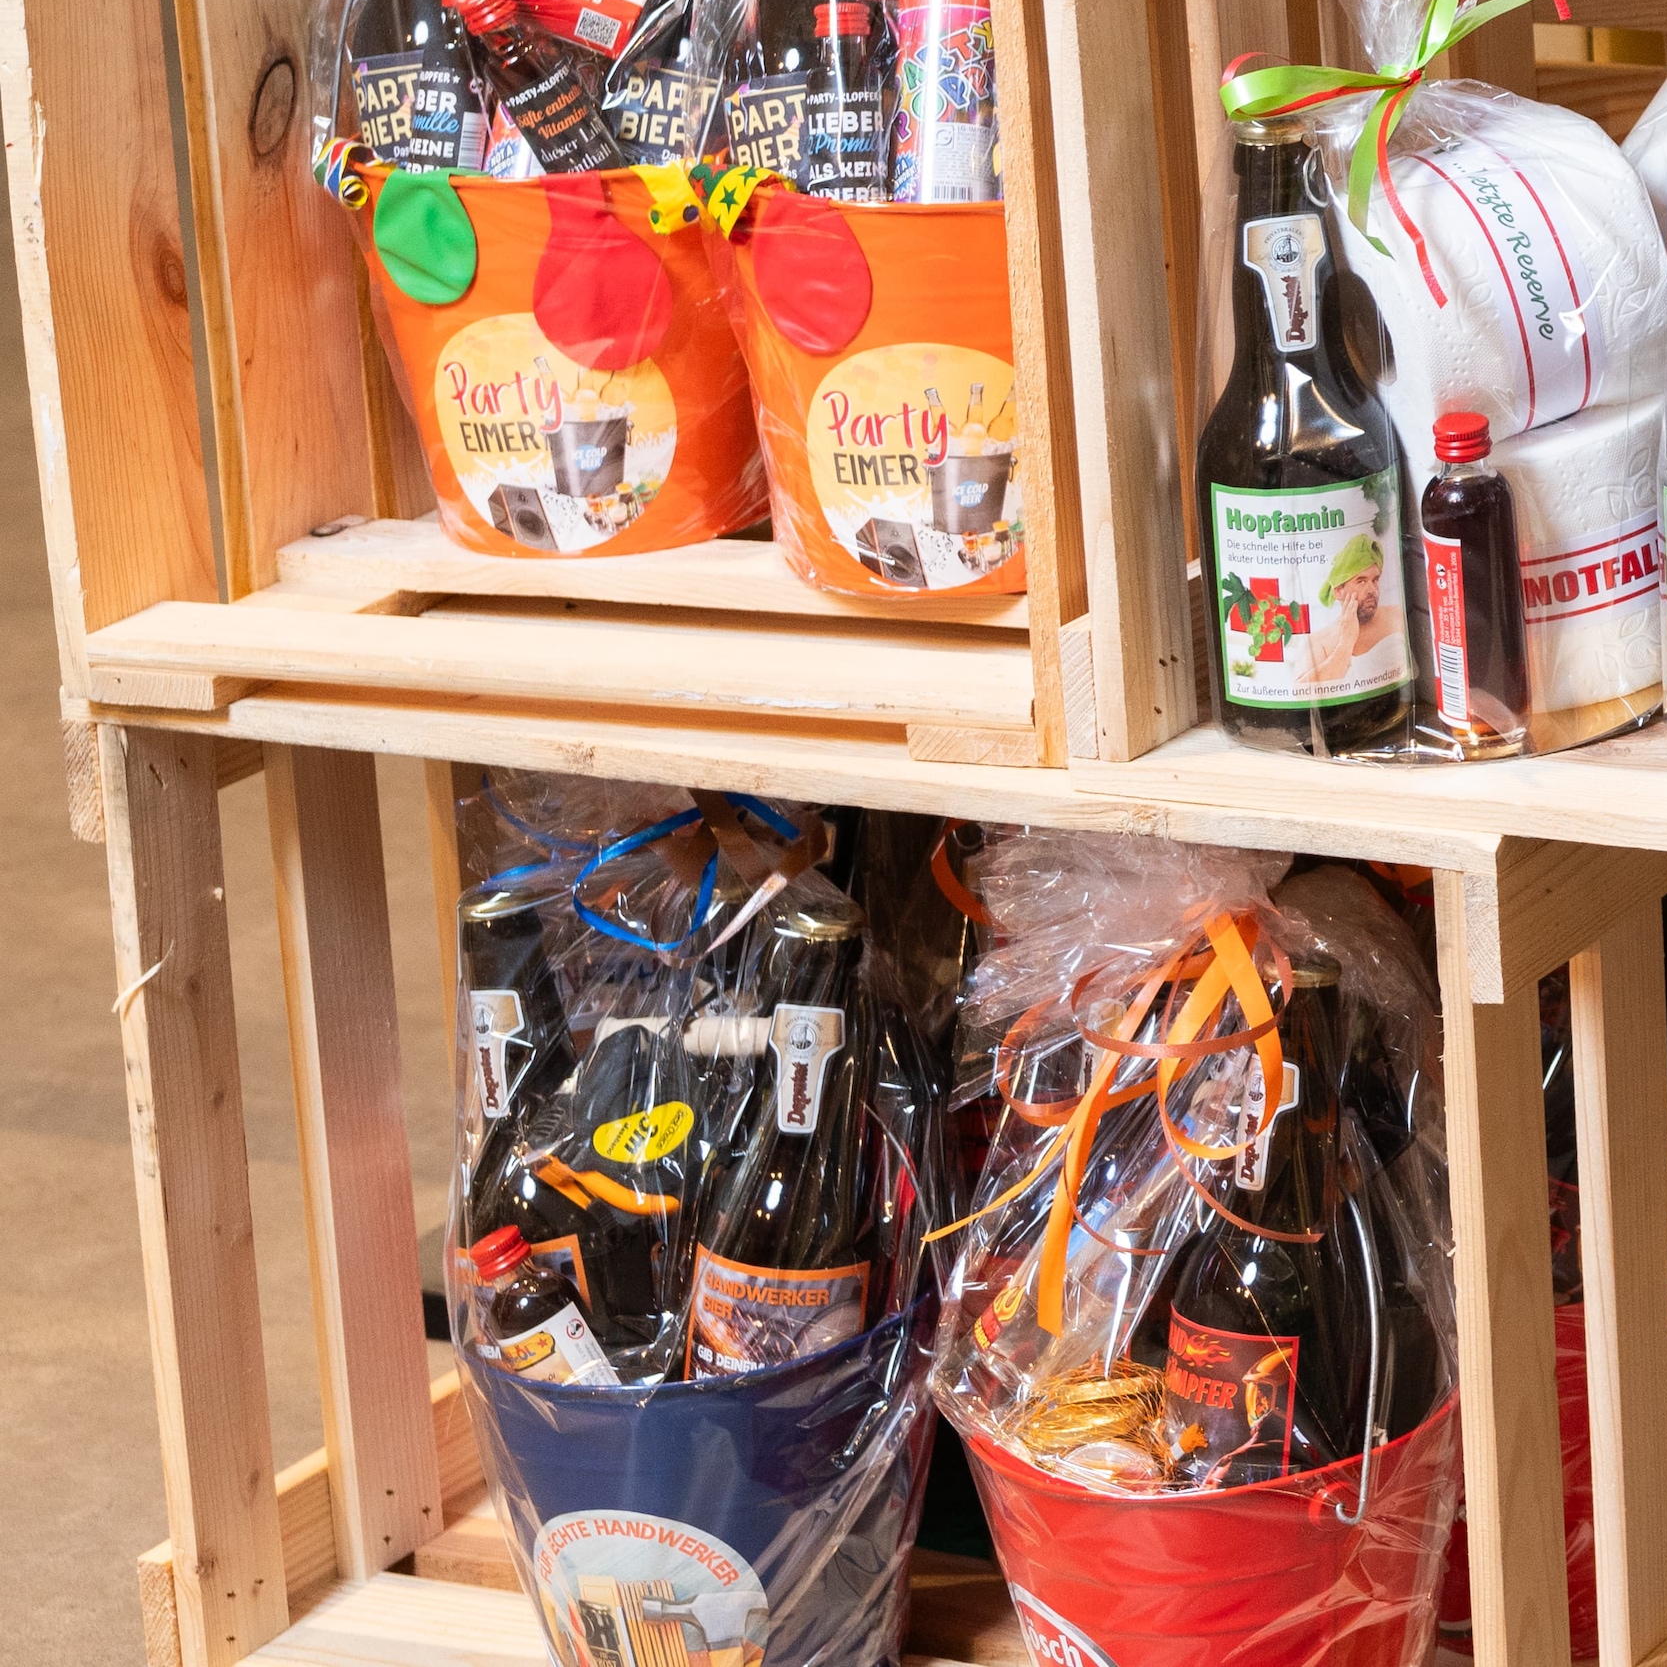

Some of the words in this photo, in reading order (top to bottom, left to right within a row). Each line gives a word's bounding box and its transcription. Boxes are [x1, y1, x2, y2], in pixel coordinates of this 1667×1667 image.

[362, 112, 412, 147] BIER
[809, 111, 884, 135] LIEBER
[737, 133, 801, 167] BIER
[810, 164, 834, 179] ALS
[1506, 231, 1554, 341] Reserve
[443, 359, 565, 434] Party
[460, 418, 550, 455] EIMER
[823, 388, 951, 468] Party
[580, 456, 603, 470] BEER
[586, 444, 608, 461] COLD
[833, 451, 931, 486] EIMER
[960, 492, 982, 507] BEER
[967, 481, 989, 496] COLD
[1226, 505, 1345, 539] Hopfamin
[1227, 539, 1241, 550] Die
[1242, 540, 1279, 551] schnelle
[1282, 540, 1305, 551] Hilfe
[1309, 539, 1324, 550] bei
[1228, 554, 1253, 564] akuter
[1256, 553, 1328, 570] Unterhopfung.
[1237, 683, 1250, 694] Zur
[1252, 684, 1289, 697] äußeren
[1292, 686, 1311, 696] und
[1315, 682, 1351, 695] inneren
[705, 1271, 830, 1308] HANDWERKER
[702, 1297, 734, 1320] BIER
[696, 1345, 714, 1363] GIB
[546, 1517, 592, 1560] ECHTE
[594, 1517, 741, 1588] HANDWERKER
